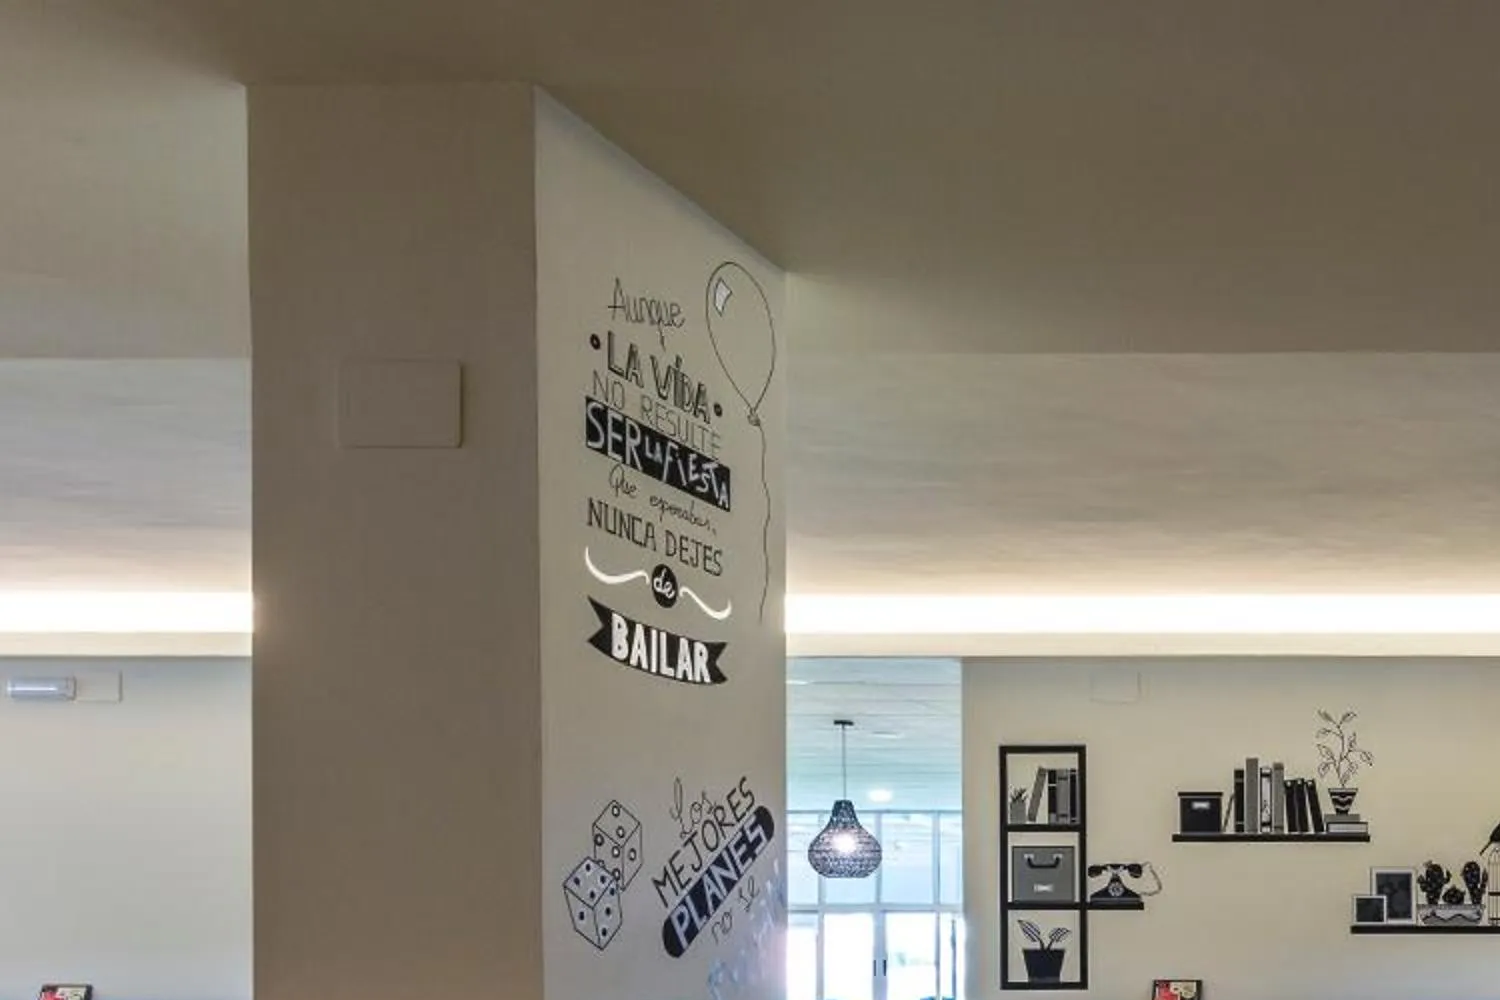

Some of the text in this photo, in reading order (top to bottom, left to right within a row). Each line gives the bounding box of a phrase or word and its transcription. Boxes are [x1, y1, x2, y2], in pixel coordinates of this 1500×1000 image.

[607, 277, 686, 351] Aunque
[608, 331, 645, 388] LA
[586, 401, 643, 472] SER
[645, 436, 663, 465] LA
[593, 369, 720, 460] NO RESULTE
[609, 463, 637, 498] Que
[587, 497, 724, 577] NUNCA DEJES
[653, 567, 676, 599] de
[611, 611, 712, 684] BAILAR
[652, 776, 755, 908] MEJORES
[669, 813, 768, 951] PLANES
